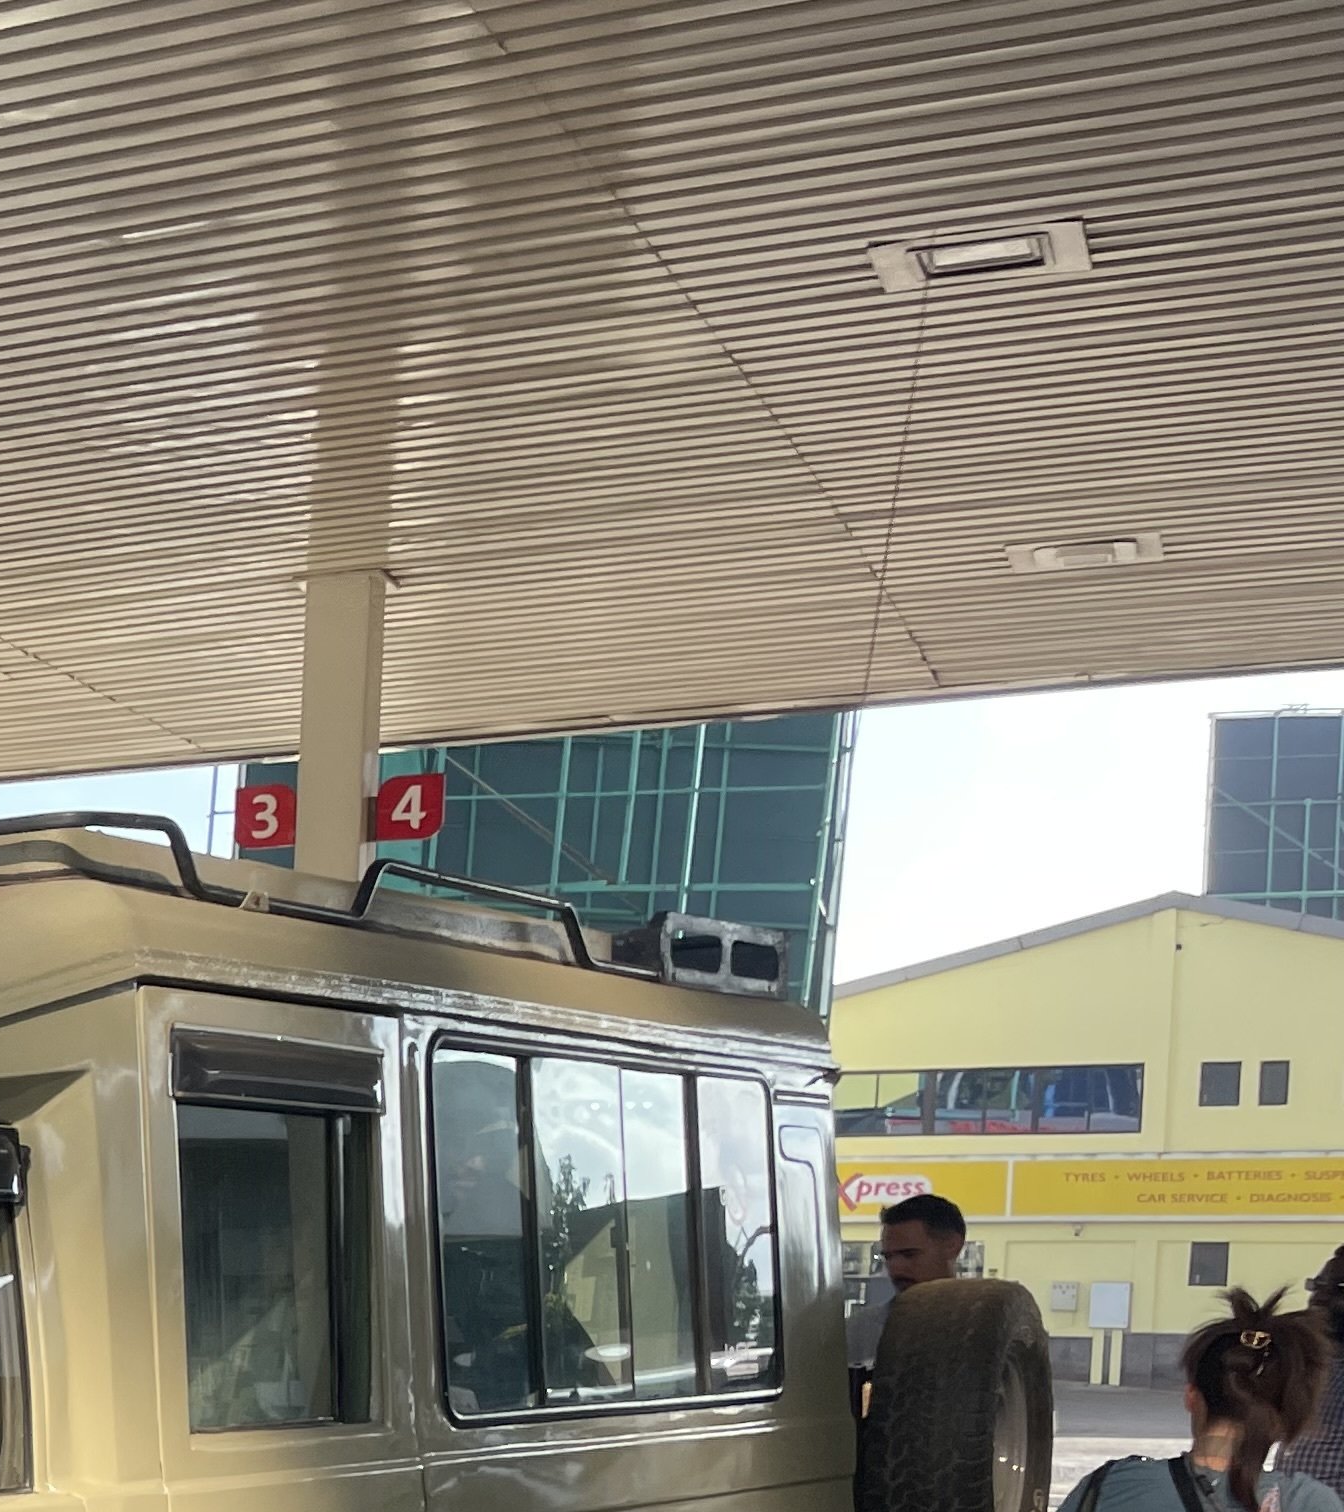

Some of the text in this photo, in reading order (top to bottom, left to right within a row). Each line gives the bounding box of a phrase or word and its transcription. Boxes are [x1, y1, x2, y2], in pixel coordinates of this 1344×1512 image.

[251, 794, 279, 839] 3
[391, 785, 427, 830] 4
[1063, 1172, 1106, 1183] TYRES
[1127, 1171, 1185, 1183] WHEELS
[1206, 1170, 1283, 1181] BATTERIES
[1137, 1192, 1166, 1204] CAR
[1170, 1192, 1229, 1204] SERVICE
